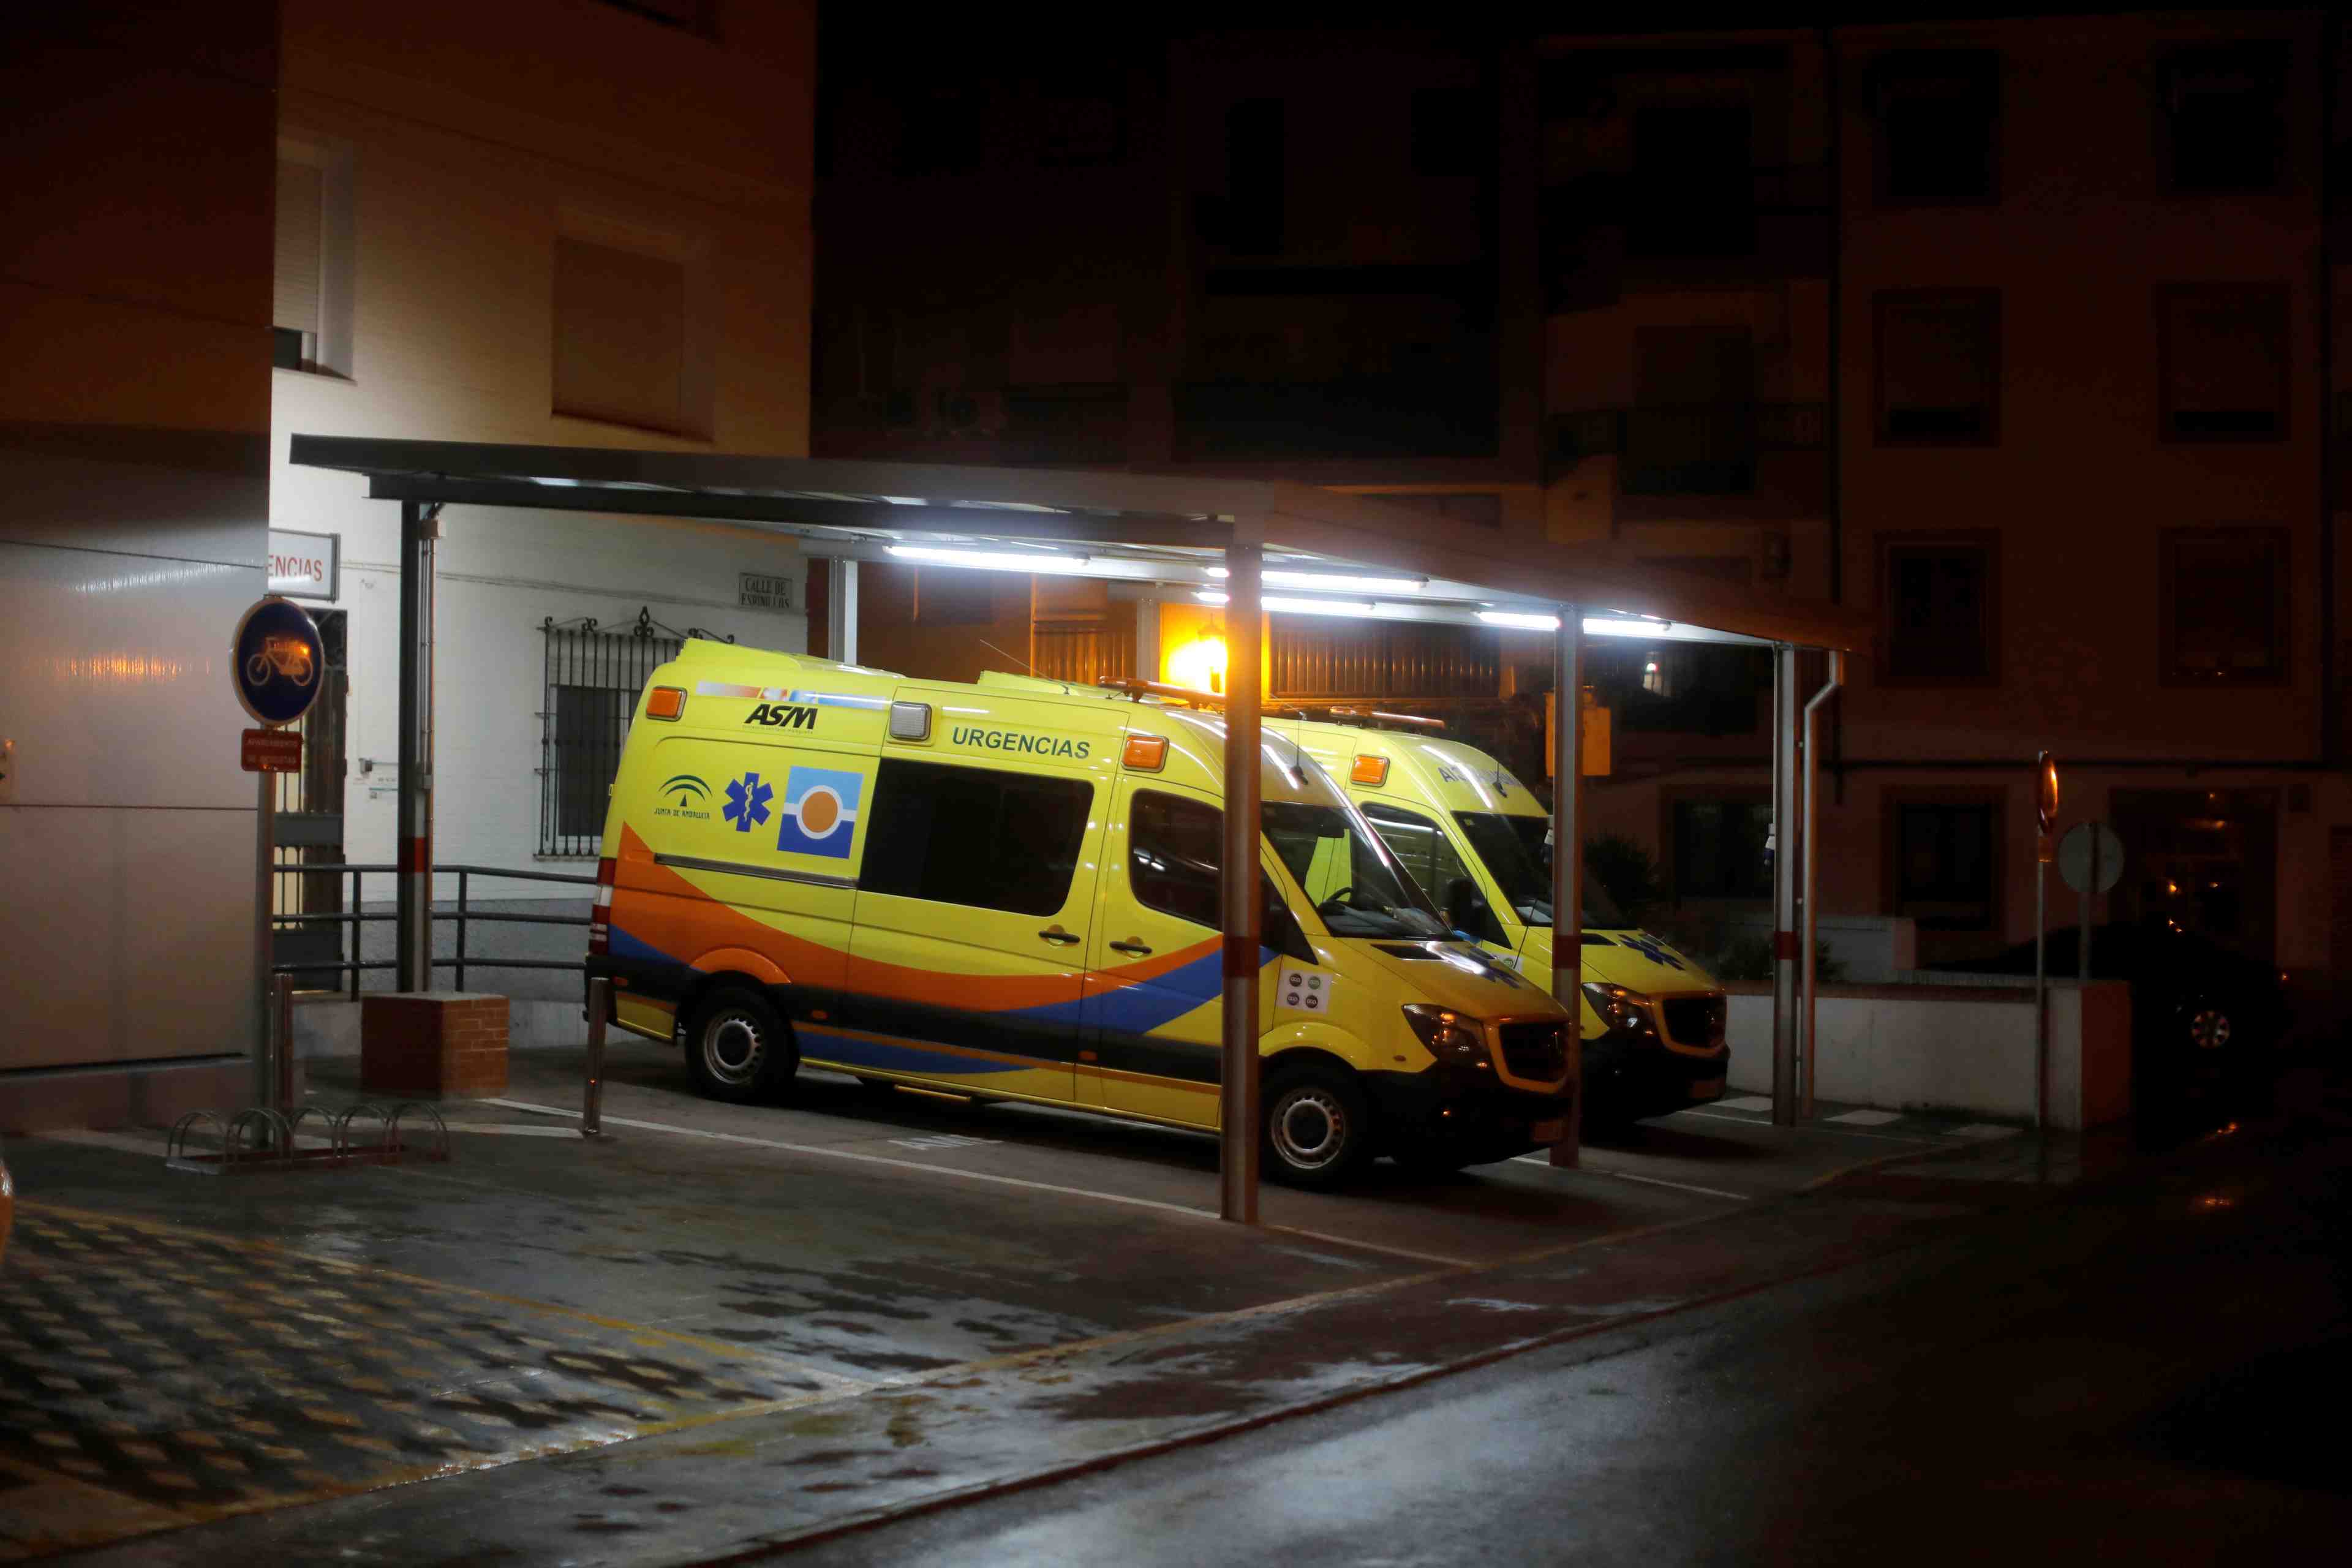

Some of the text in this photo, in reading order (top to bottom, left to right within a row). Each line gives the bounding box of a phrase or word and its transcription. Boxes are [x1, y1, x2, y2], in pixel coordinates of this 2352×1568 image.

[775, 580, 786, 595] DE
[744, 703, 818, 729] ASM
[952, 726, 1090, 760] URGENCIAS
